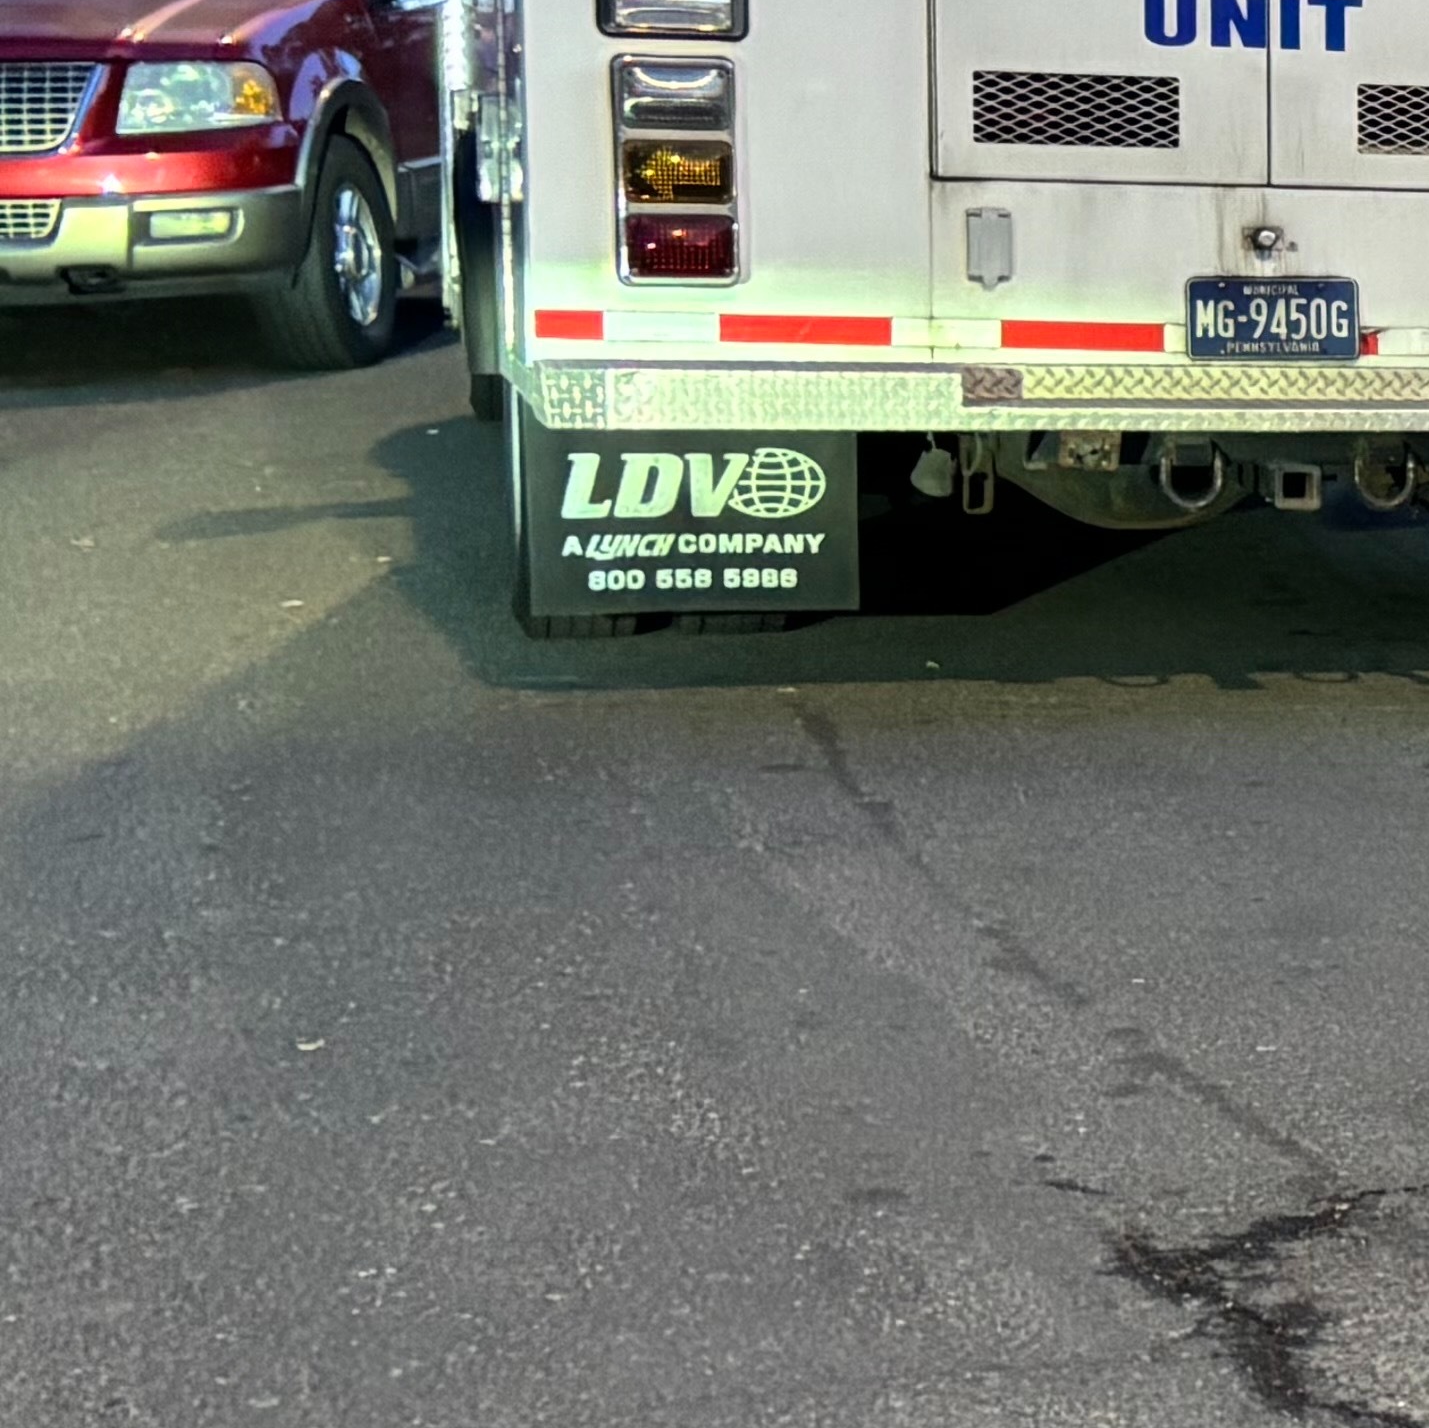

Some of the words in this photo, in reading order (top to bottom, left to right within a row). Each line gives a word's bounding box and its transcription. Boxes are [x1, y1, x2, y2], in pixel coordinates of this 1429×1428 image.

[1242, 283, 1300, 296] MUNICIPAL
[1195, 297, 1350, 340] MG-9450G
[1226, 341, 1321, 354] PENNSYLVANIA
[561, 452, 750, 519] LDV
[561, 535, 583, 557] A
[584, 533, 676, 561] LYNCH
[677, 532, 826, 554] COMPANY
[587, 568, 647, 592] 800
